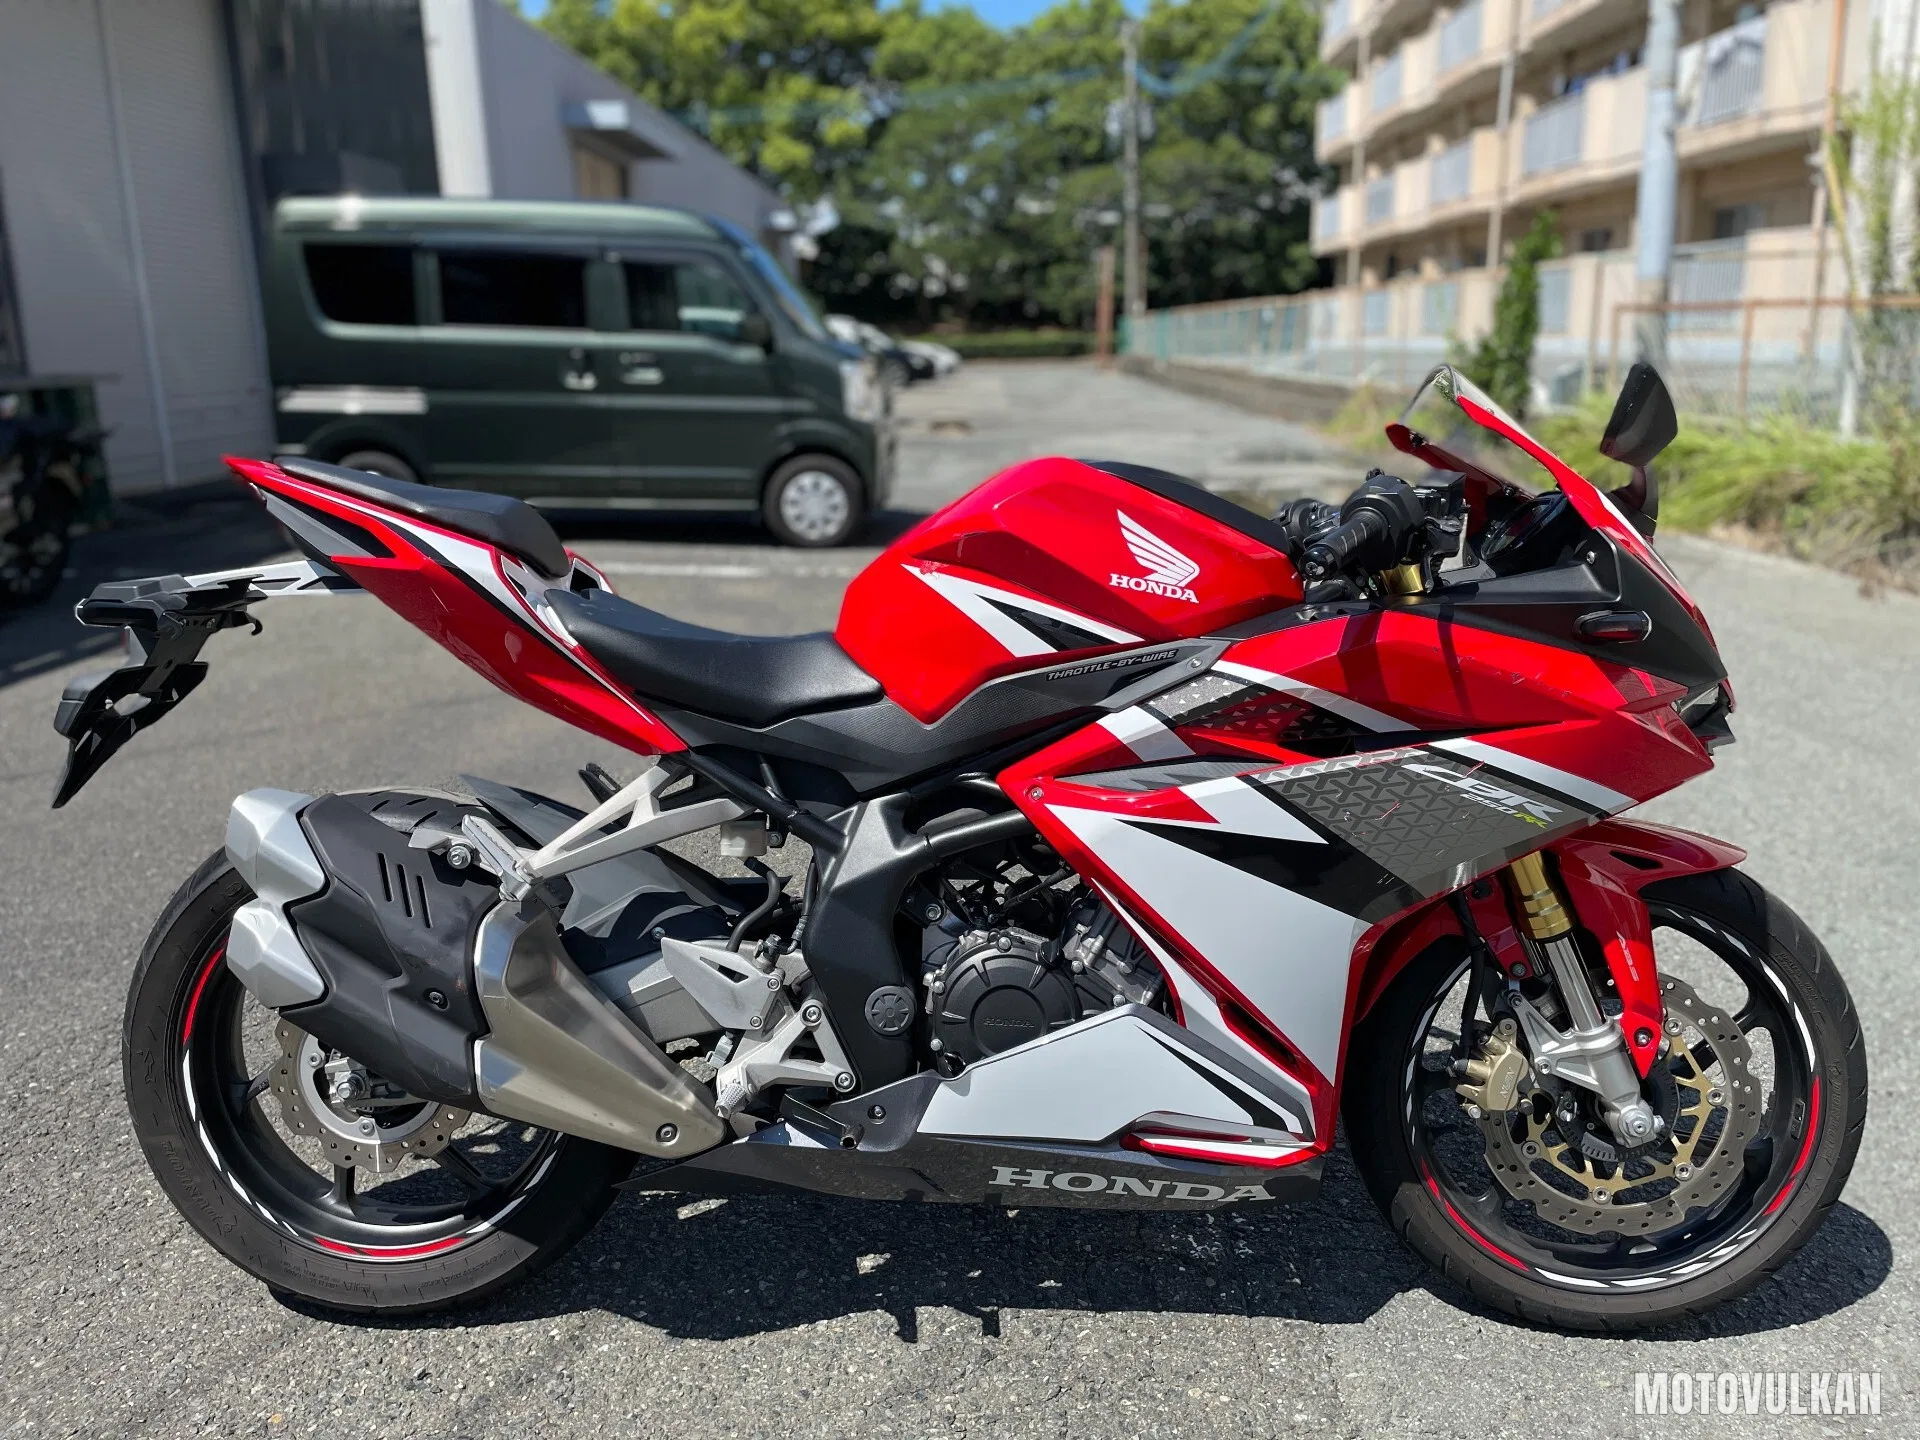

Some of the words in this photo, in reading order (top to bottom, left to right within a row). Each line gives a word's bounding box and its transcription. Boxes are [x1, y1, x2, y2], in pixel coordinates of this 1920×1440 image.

[1109, 573, 1199, 604] HONDA
[1046, 649, 1178, 681] THROTTLE-BY-WIRE
[1401, 763, 1564, 823] CBR
[988, 1165, 1276, 1202] HONDA
